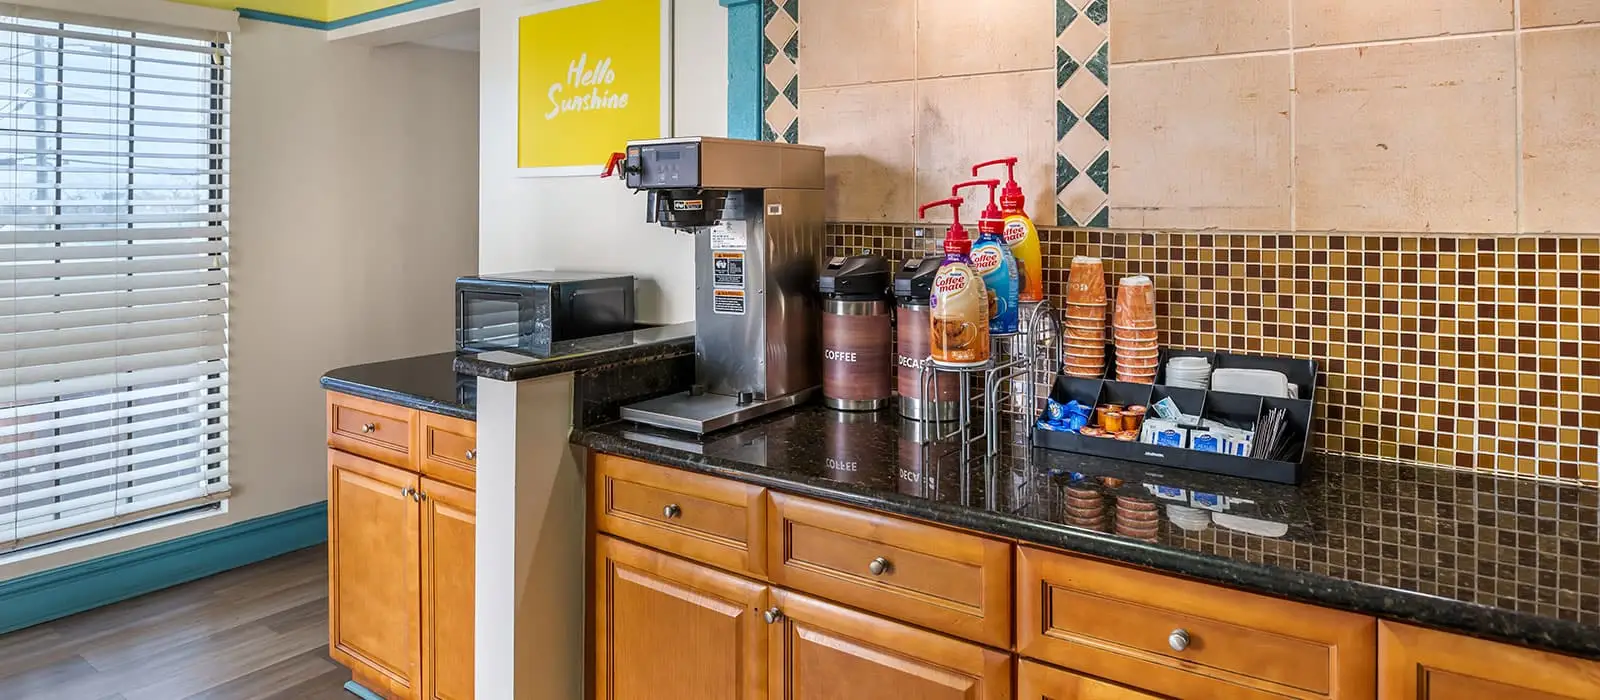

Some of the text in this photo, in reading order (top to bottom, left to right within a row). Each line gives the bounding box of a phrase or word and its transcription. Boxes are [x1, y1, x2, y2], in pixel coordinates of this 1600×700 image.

[567, 52, 616, 88] Hello
[544, 82, 629, 120] Sunshine
[1003, 227, 1024, 236] offee
[935, 275, 965, 288] Coffee
[940, 282, 965, 293] mate
[825, 349, 857, 362] COFFEE
